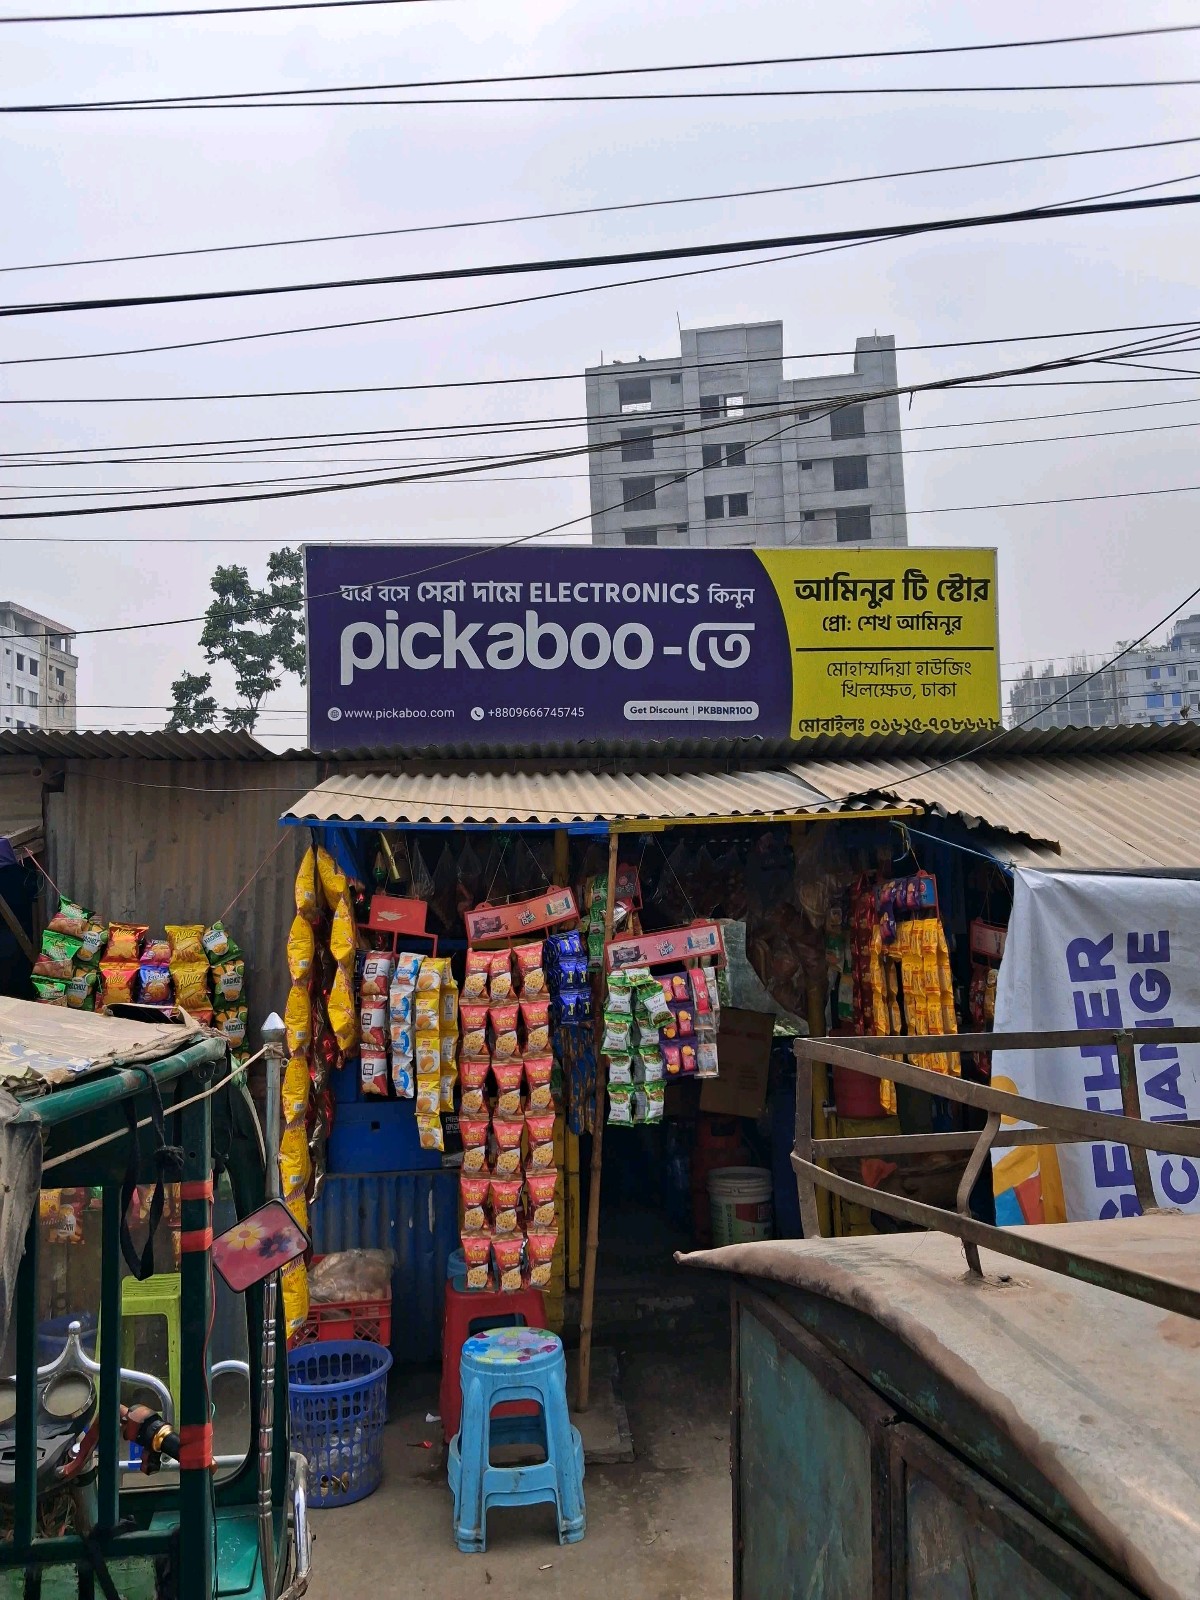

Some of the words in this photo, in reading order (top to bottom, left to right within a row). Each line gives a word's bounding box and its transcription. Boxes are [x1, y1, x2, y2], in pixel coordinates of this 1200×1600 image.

[340, 585, 373, 602] ঘরে
[377, 585, 411, 603] বসে
[417, 579, 467, 604] সেরা
[472, 580, 524, 603] দামে
[529, 582, 700, 604] ELECTRONICS
[707, 583, 756, 609] কিনুন
[794, 571, 895, 609] আমিনুর
[902, 568, 929, 601] টি
[937, 573, 991, 603] স্টোর
[857, 614, 892, 631] শেখ
[896, 611, 963, 636] আমিনুর
[827, 658, 911, 678] মোহাম্মদিয়া
[915, 658, 972, 676] হাউজিং
[841, 680, 916, 699] খিলক্ষেত,
[921, 682, 957, 698] ঢাকা
[344, 707, 455, 721] www.pickaboo.com
[488, 707, 585, 718] +8809666745745
[630, 706, 648, 714] Get
[649, 706, 689, 715] Discount
[697, 706, 753, 715] PKBBNR100
[1065, 932, 1144, 1220] EHER
[1127, 930, 1200, 1205] CANGE
